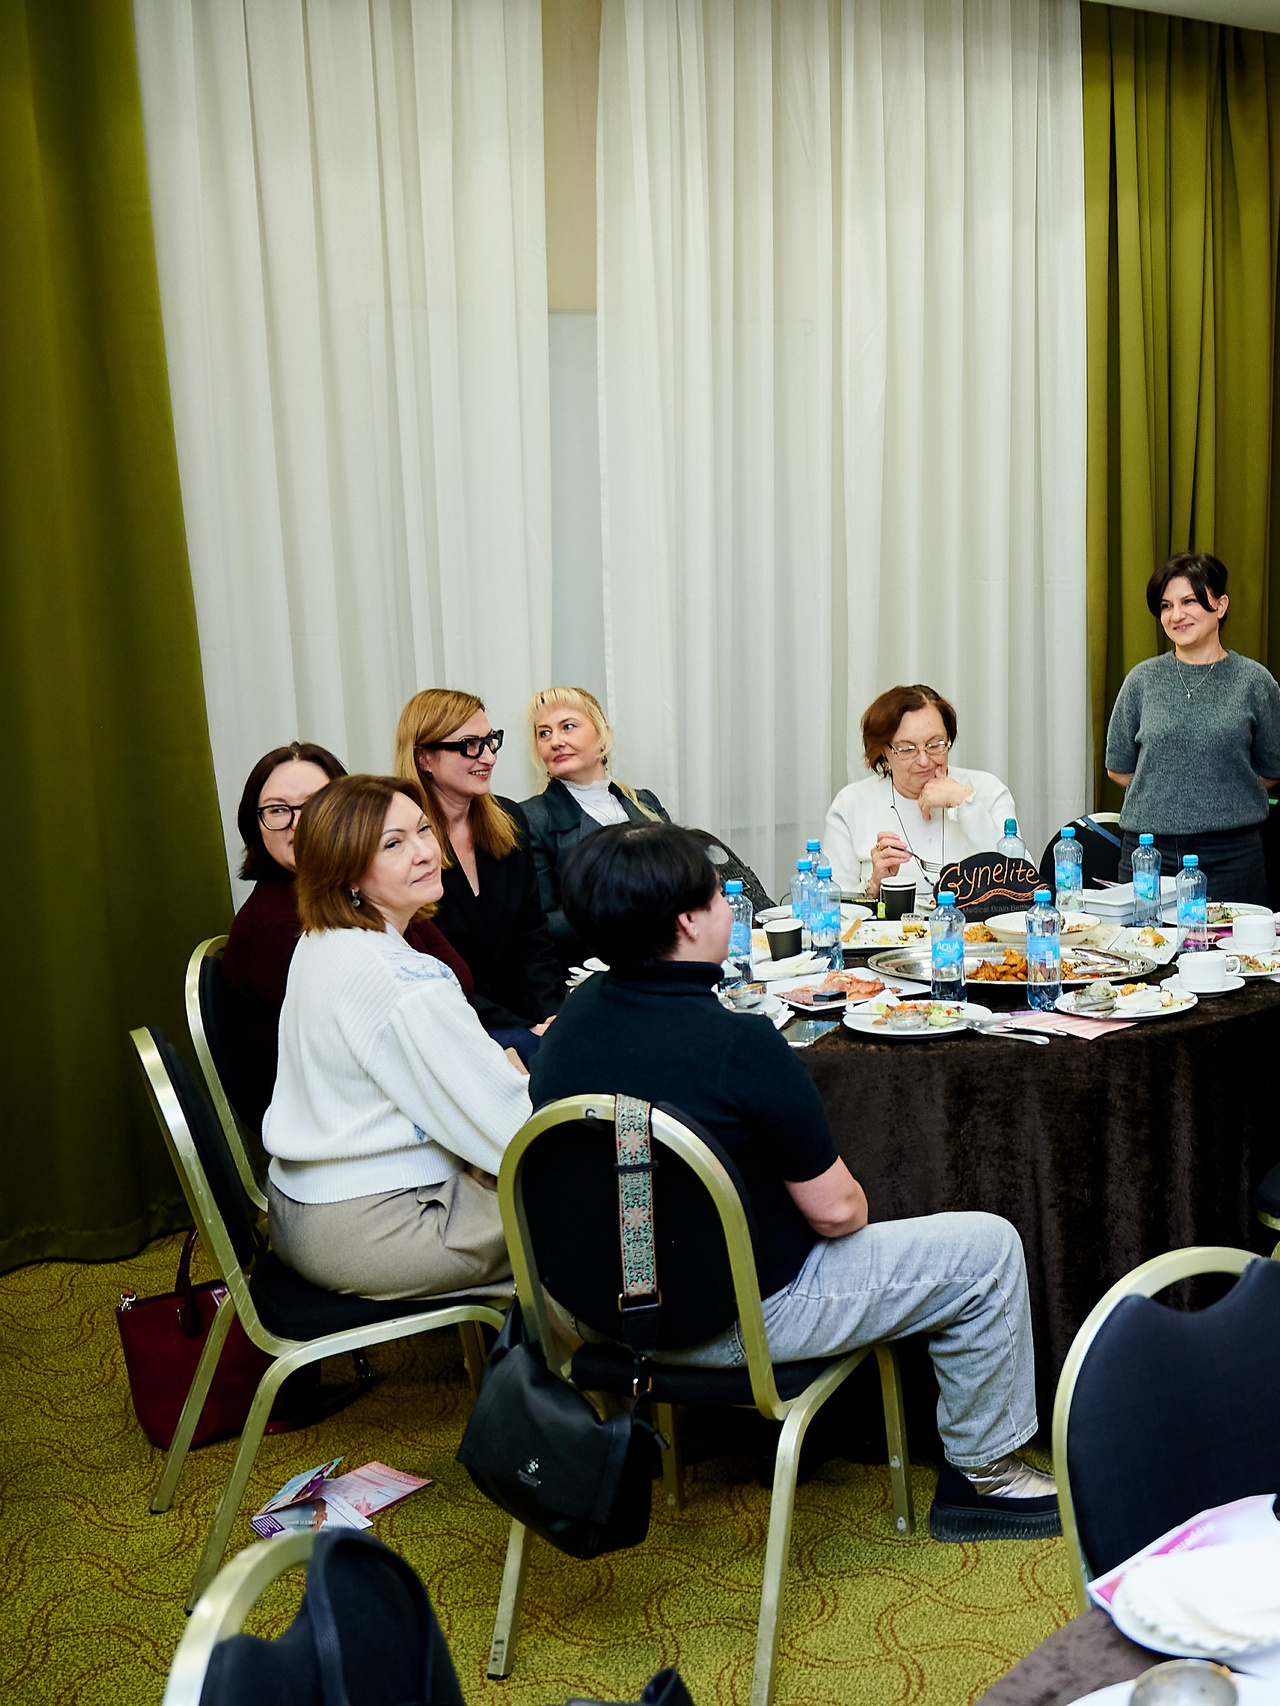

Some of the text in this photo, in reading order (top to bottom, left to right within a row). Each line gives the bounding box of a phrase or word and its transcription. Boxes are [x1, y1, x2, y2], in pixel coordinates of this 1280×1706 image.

[938, 858, 1040, 900] Gynelite
[962, 905, 990, 914] Medical
[936, 941, 961, 951] AQUA
